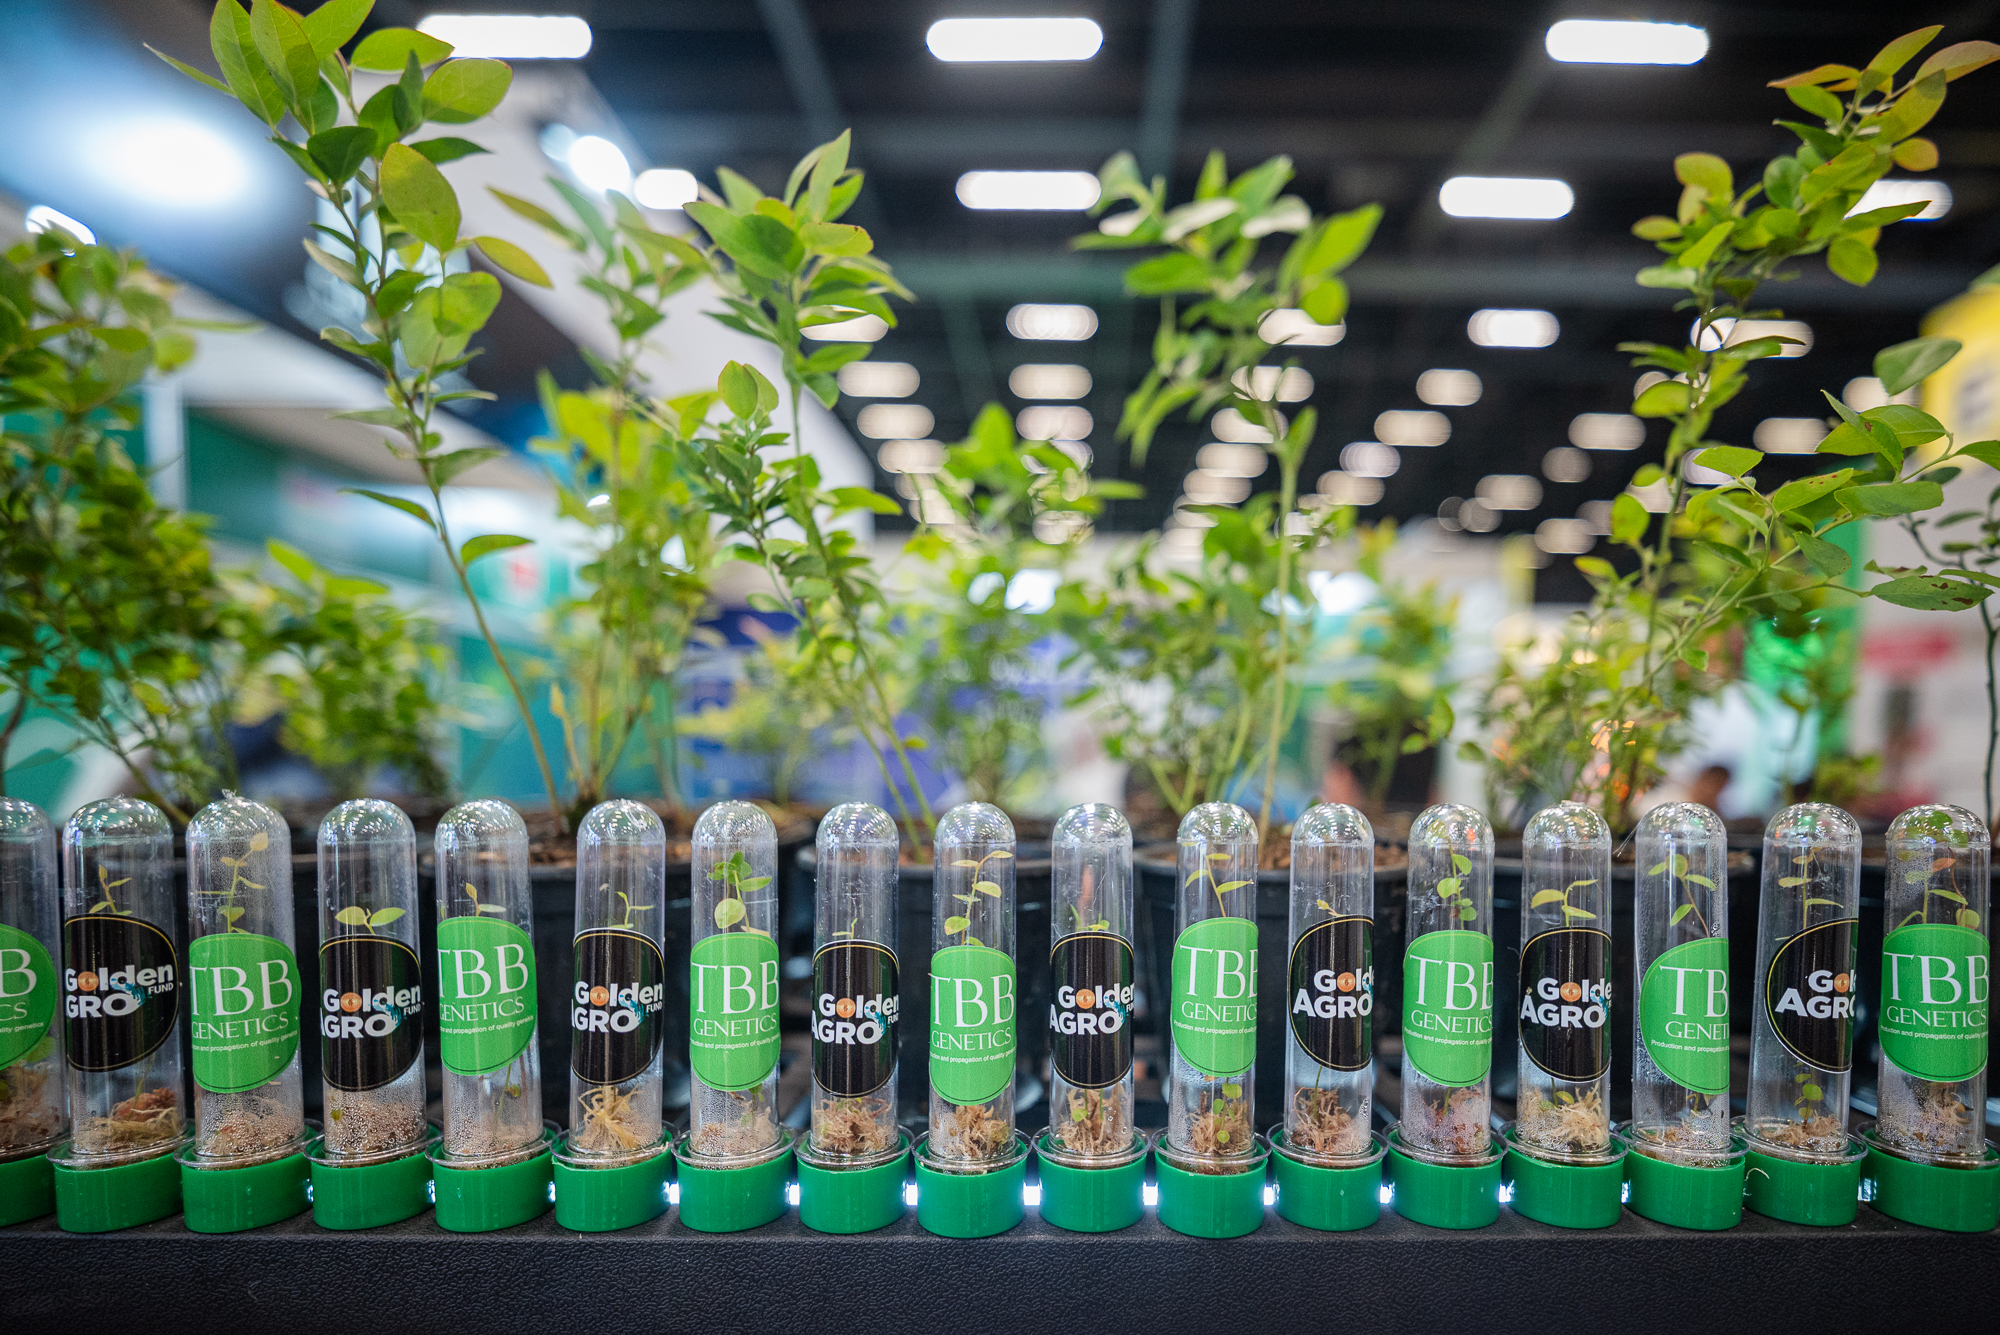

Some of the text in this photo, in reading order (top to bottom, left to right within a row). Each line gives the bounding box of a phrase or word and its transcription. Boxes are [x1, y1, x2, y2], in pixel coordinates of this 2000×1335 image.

[65, 964, 174, 992] Golden
[437, 944, 528, 999] TBB
[1808, 969, 1856, 993] Gol
[1883, 952, 1989, 1005] TBB
[148, 982, 174, 994] FUND
[190, 960, 293, 1016] TBB
[323, 985, 421, 1012] Golden
[575, 982, 663, 1007] Golden
[691, 960, 779, 1014] TBB
[404, 1003, 421, 1016] FUND
[646, 1002, 662, 1013] FUND
[818, 993, 899, 1018] Golden
[930, 973, 1014, 1027] TBB
[1293, 988, 1373, 1019] AGRO
[1520, 995, 1607, 1028] AGRO
[192, 1012, 288, 1039] GENETICS
[320, 1007, 400, 1039] GRO
[496, 1022, 515, 1030] quality
[571, 999, 643, 1033] GRO
[693, 1013, 776, 1037] GENETICS
[1050, 1004, 1125, 1035] AGRO
[1887, 1006, 1986, 1028] GENETICS
[210, 1043, 248, 1052] propagation
[259, 1037, 279, 1046] quality
[931, 1027, 1011, 1050] GENETICS
[1651, 1040, 1682, 1050] Production
[1914, 1032, 1955, 1040] propagation
[990, 1053, 1004, 1061] quality
